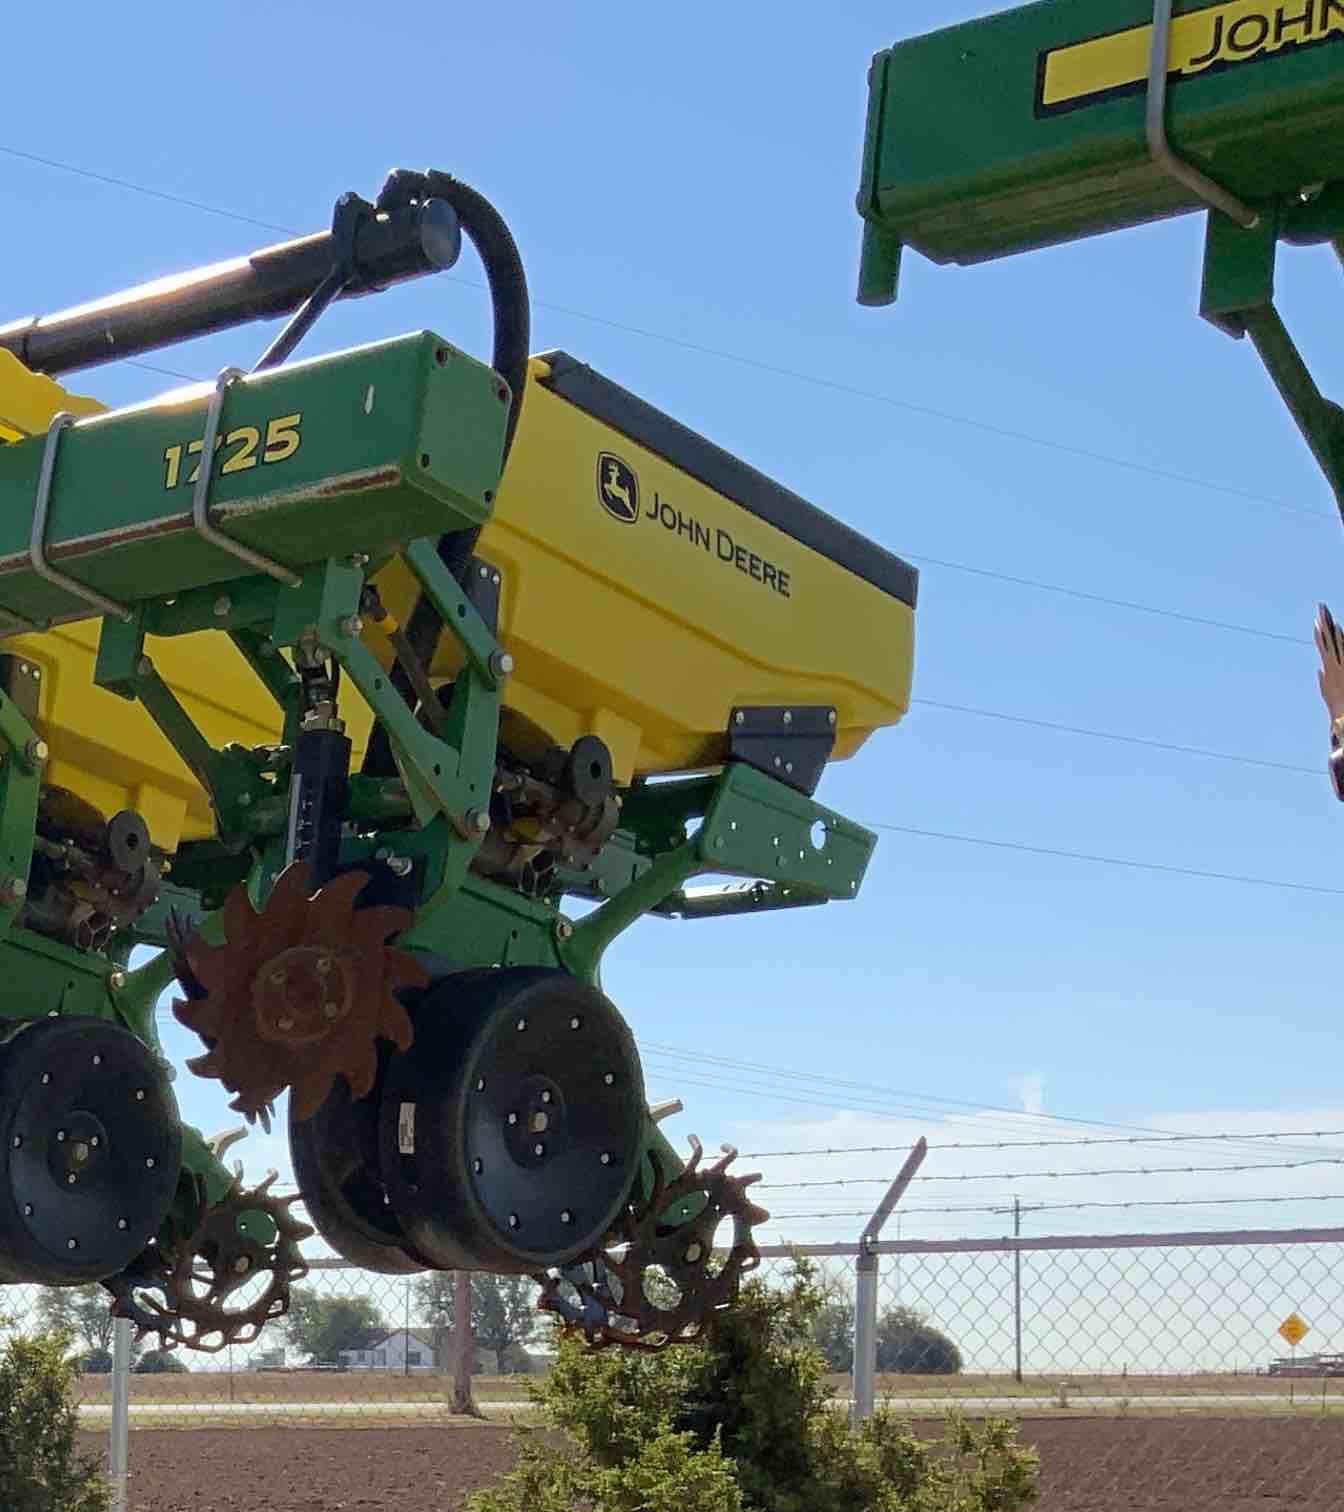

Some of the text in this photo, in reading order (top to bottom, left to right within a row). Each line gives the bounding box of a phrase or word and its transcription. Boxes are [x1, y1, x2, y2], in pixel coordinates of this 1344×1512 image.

[165, 413, 302, 490] 1725
[646, 492, 791, 598] JOHN DEERE
